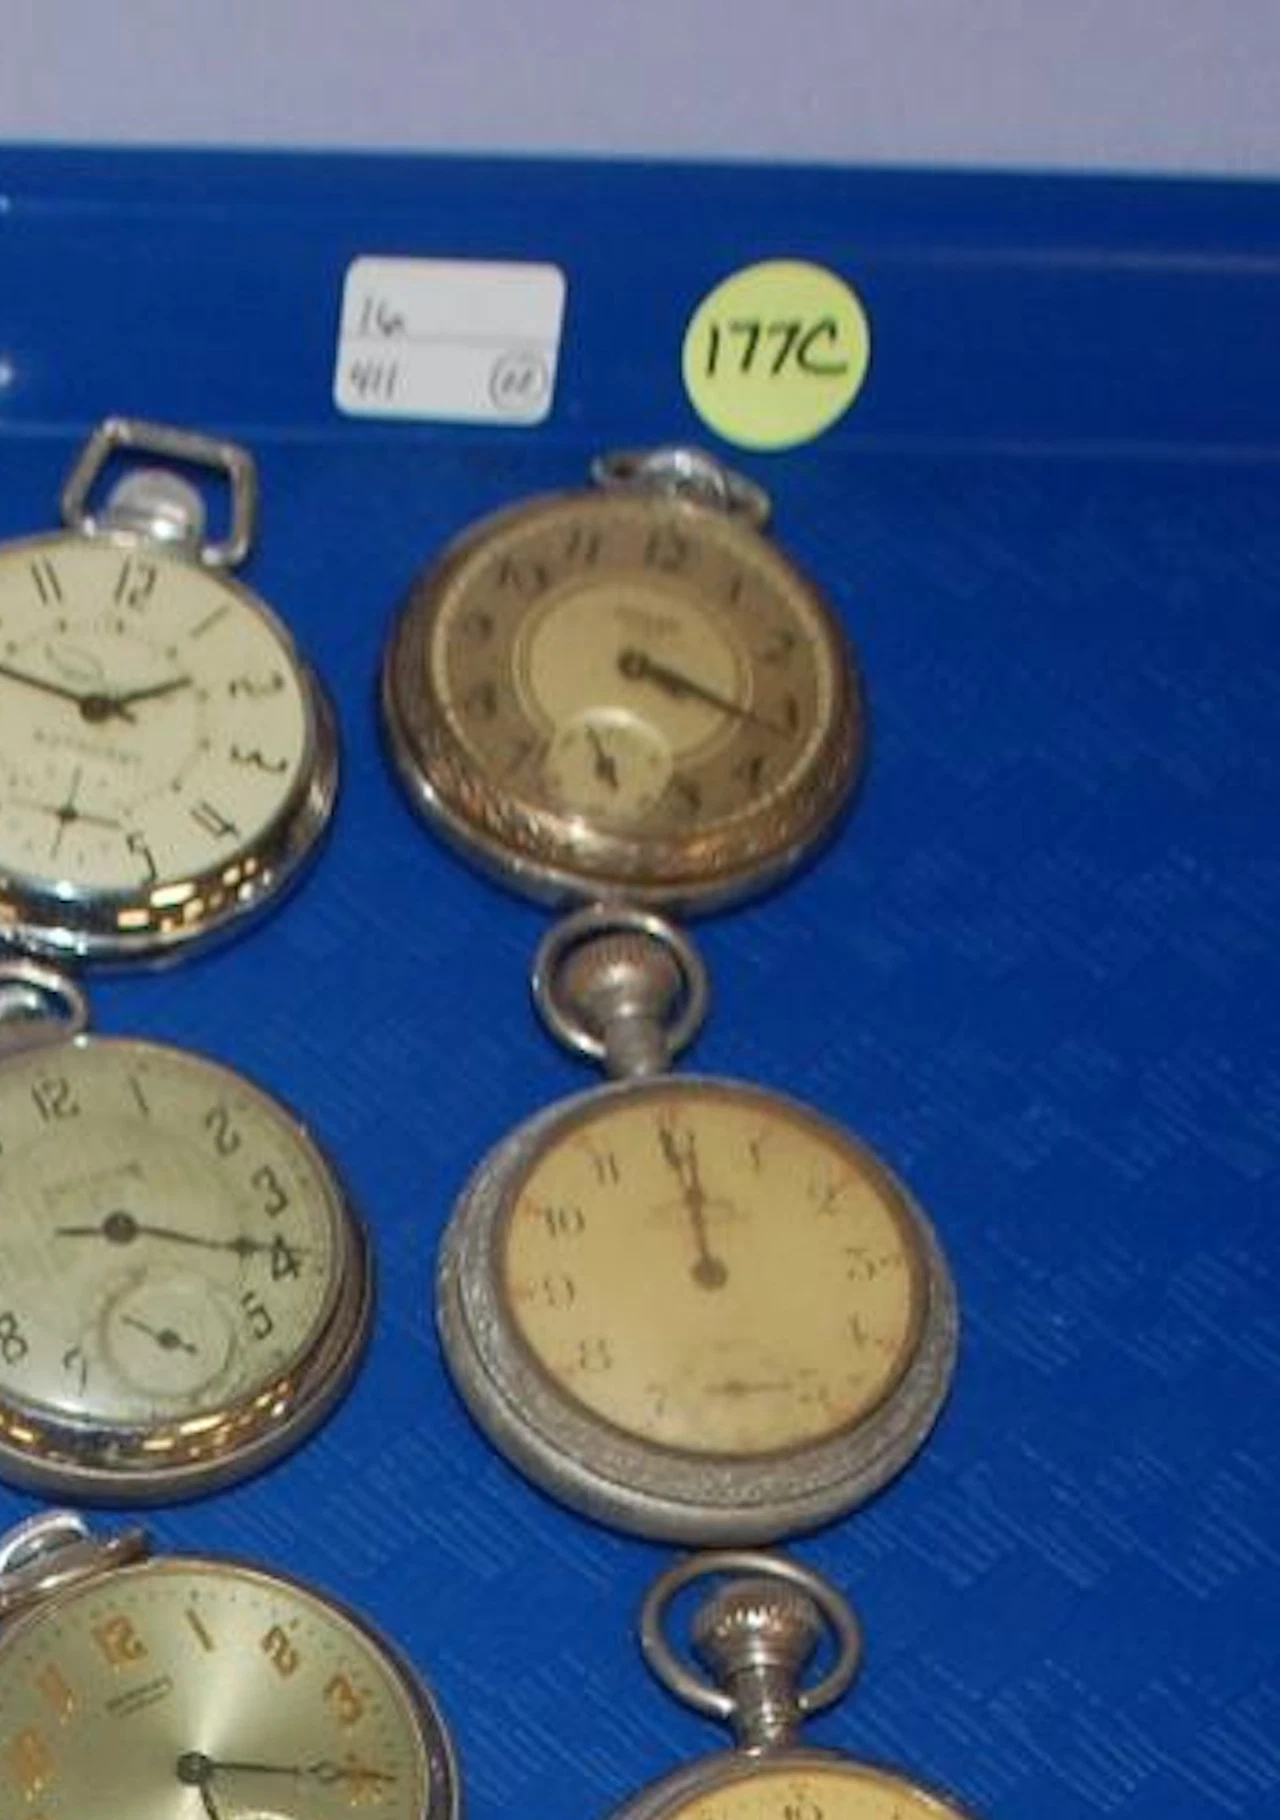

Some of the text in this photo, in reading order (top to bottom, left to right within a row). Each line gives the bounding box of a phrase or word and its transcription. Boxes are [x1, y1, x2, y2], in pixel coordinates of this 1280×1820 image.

[704, 316, 849, 378] 177C
[31, 1076, 81, 1122] 12
[204, 1106, 241, 1156] 2
[251, 1165, 288, 1219] 3
[239, 1291, 273, 1341] 5
